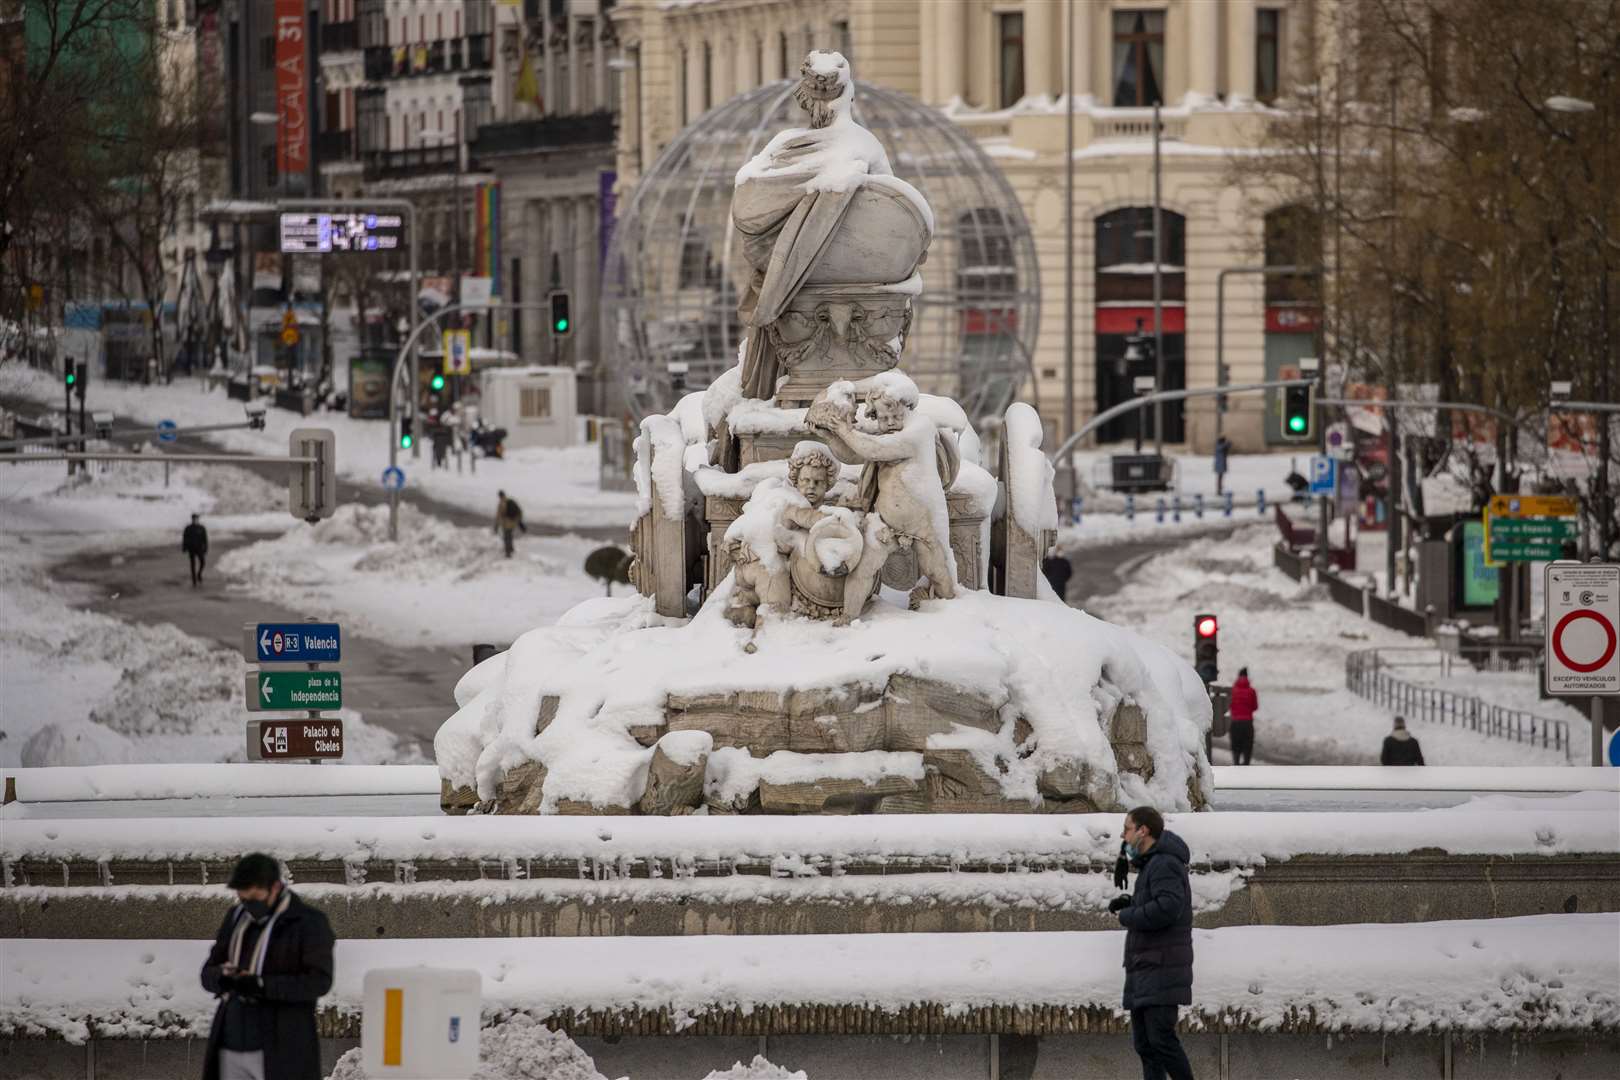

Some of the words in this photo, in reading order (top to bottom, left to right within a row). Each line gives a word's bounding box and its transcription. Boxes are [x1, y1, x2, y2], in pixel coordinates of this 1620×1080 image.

[278, 15, 303, 43] 31
[286, 637, 298, 649] R-3
[304, 636, 337, 650] Valencia
[308, 678, 321, 688] plaza
[324, 677, 331, 686] de
[333, 677, 338, 686] la
[291, 690, 339, 703] Independencia
[303, 726, 328, 737] Palacio
[331, 725, 340, 737] de
[314, 740, 340, 752] Cibeles
